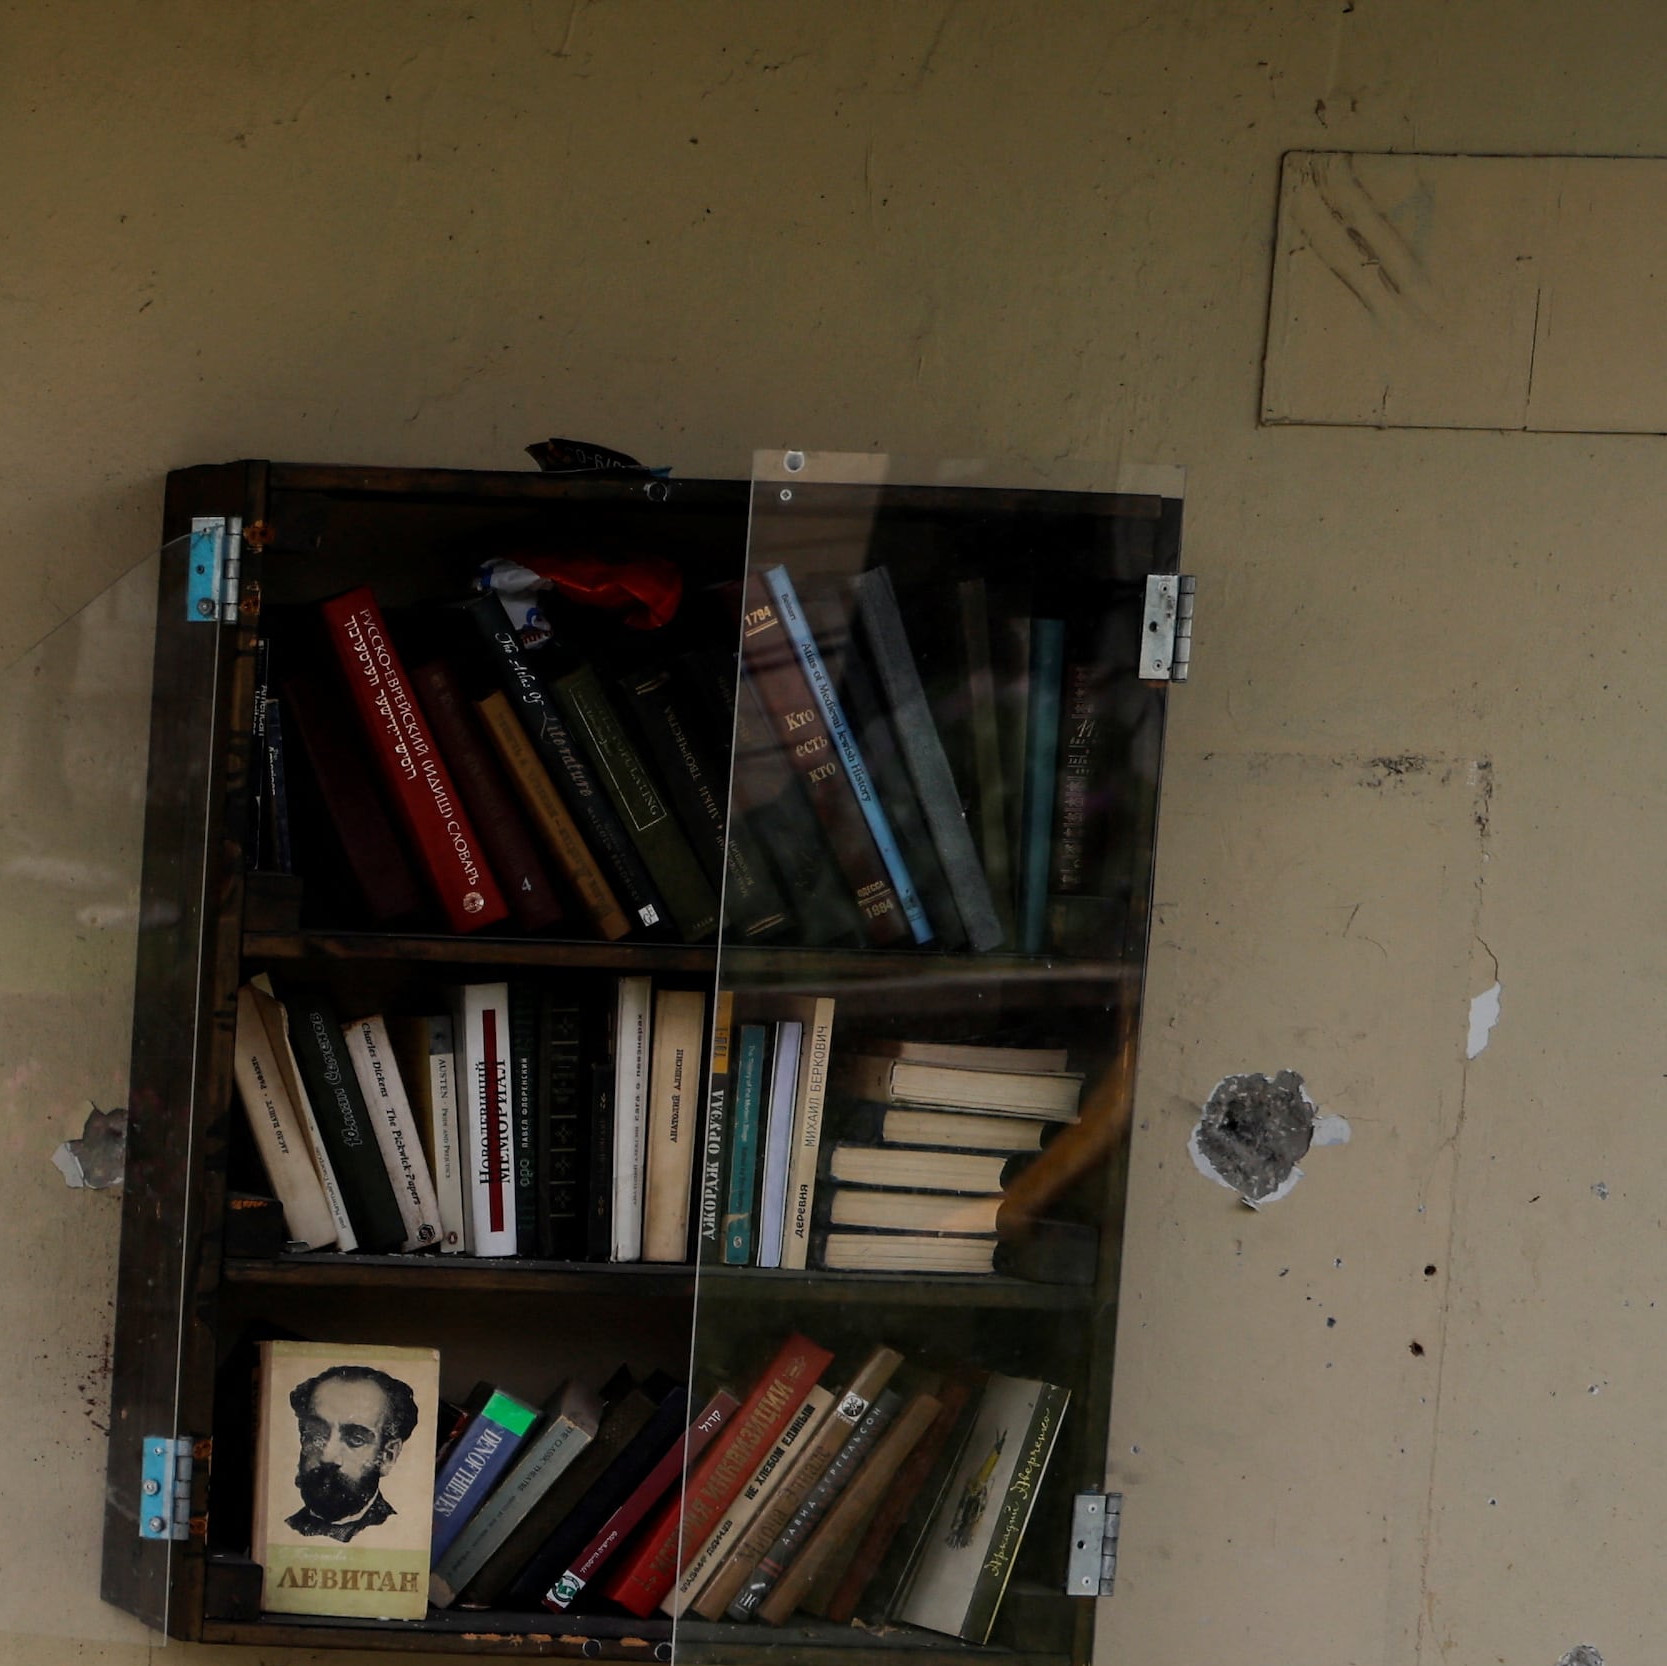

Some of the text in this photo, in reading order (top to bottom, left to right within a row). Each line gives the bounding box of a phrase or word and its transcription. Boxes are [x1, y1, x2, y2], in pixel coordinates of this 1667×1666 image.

[801, 642, 820, 670] Atlas
[811, 668, 826, 683] of
[494, 632, 592, 797] The Atlas Of Literature
[783, 705, 815, 731] Кто
[815, 682, 845, 729] Medieval
[361, 610, 428, 756] РУССКО-ЕВРЕЙСКИЙ
[421, 759, 453, 818] (ИДИШ)
[445, 820, 479, 886] СЛОВАРЬ
[792, 735, 828, 757] есть
[836, 729, 857, 764] Jewish
[806, 762, 836, 786] кто
[851, 762, 871, 802] History
[517, 875, 533, 894] 4
[438, 1058, 448, 1098] AUSTEN
[810, 1025, 828, 1092] БЕРКОВИЧ
[361, 1021, 421, 1205] Charles Dickens The Pickwick Papers
[519, 1056, 529, 1149] ПАВЕЛ ФЛОРЕНСКИЙ
[668, 1048, 684, 1143] АНАТОЛИЙ АЛЕКСИН
[275, 1130, 289, 1154] ЛАСЛО
[492, 1058, 511, 1184] МЕМОРИАЛ
[804, 1097, 820, 1147] МИХАИЛ
[701, 1087, 725, 1240] ДЖОРДЖ ОРУЭЛЛ
[473, 1427, 503, 1460] DEN
[558, 1424, 574, 1441] THE
[698, 1409, 721, 1432] קרול
[460, 1450, 488, 1475] OF
[657, 1379, 799, 1580] ИСТОРИЯ ИНКВИЗИЦИИ
[782, 1501, 816, 1545] ДАВИД
[819, 1404, 881, 1493] БЕРГЕЛЬСОН
[433, 1466, 477, 1520] THIEVES
[676, 1555, 711, 1593] ВЛАДИМИР
[742, 1483, 760, 1501] НЕ
[755, 1446, 789, 1487] ХЛЕБОМ
[779, 1404, 818, 1448] ЕДИНЫМ
[979, 1408, 1063, 1577] Аркадий Аверченко
[735, 1503, 792, 1563] Мирча
[277, 1566, 418, 1593] ЛЕВИТАН
